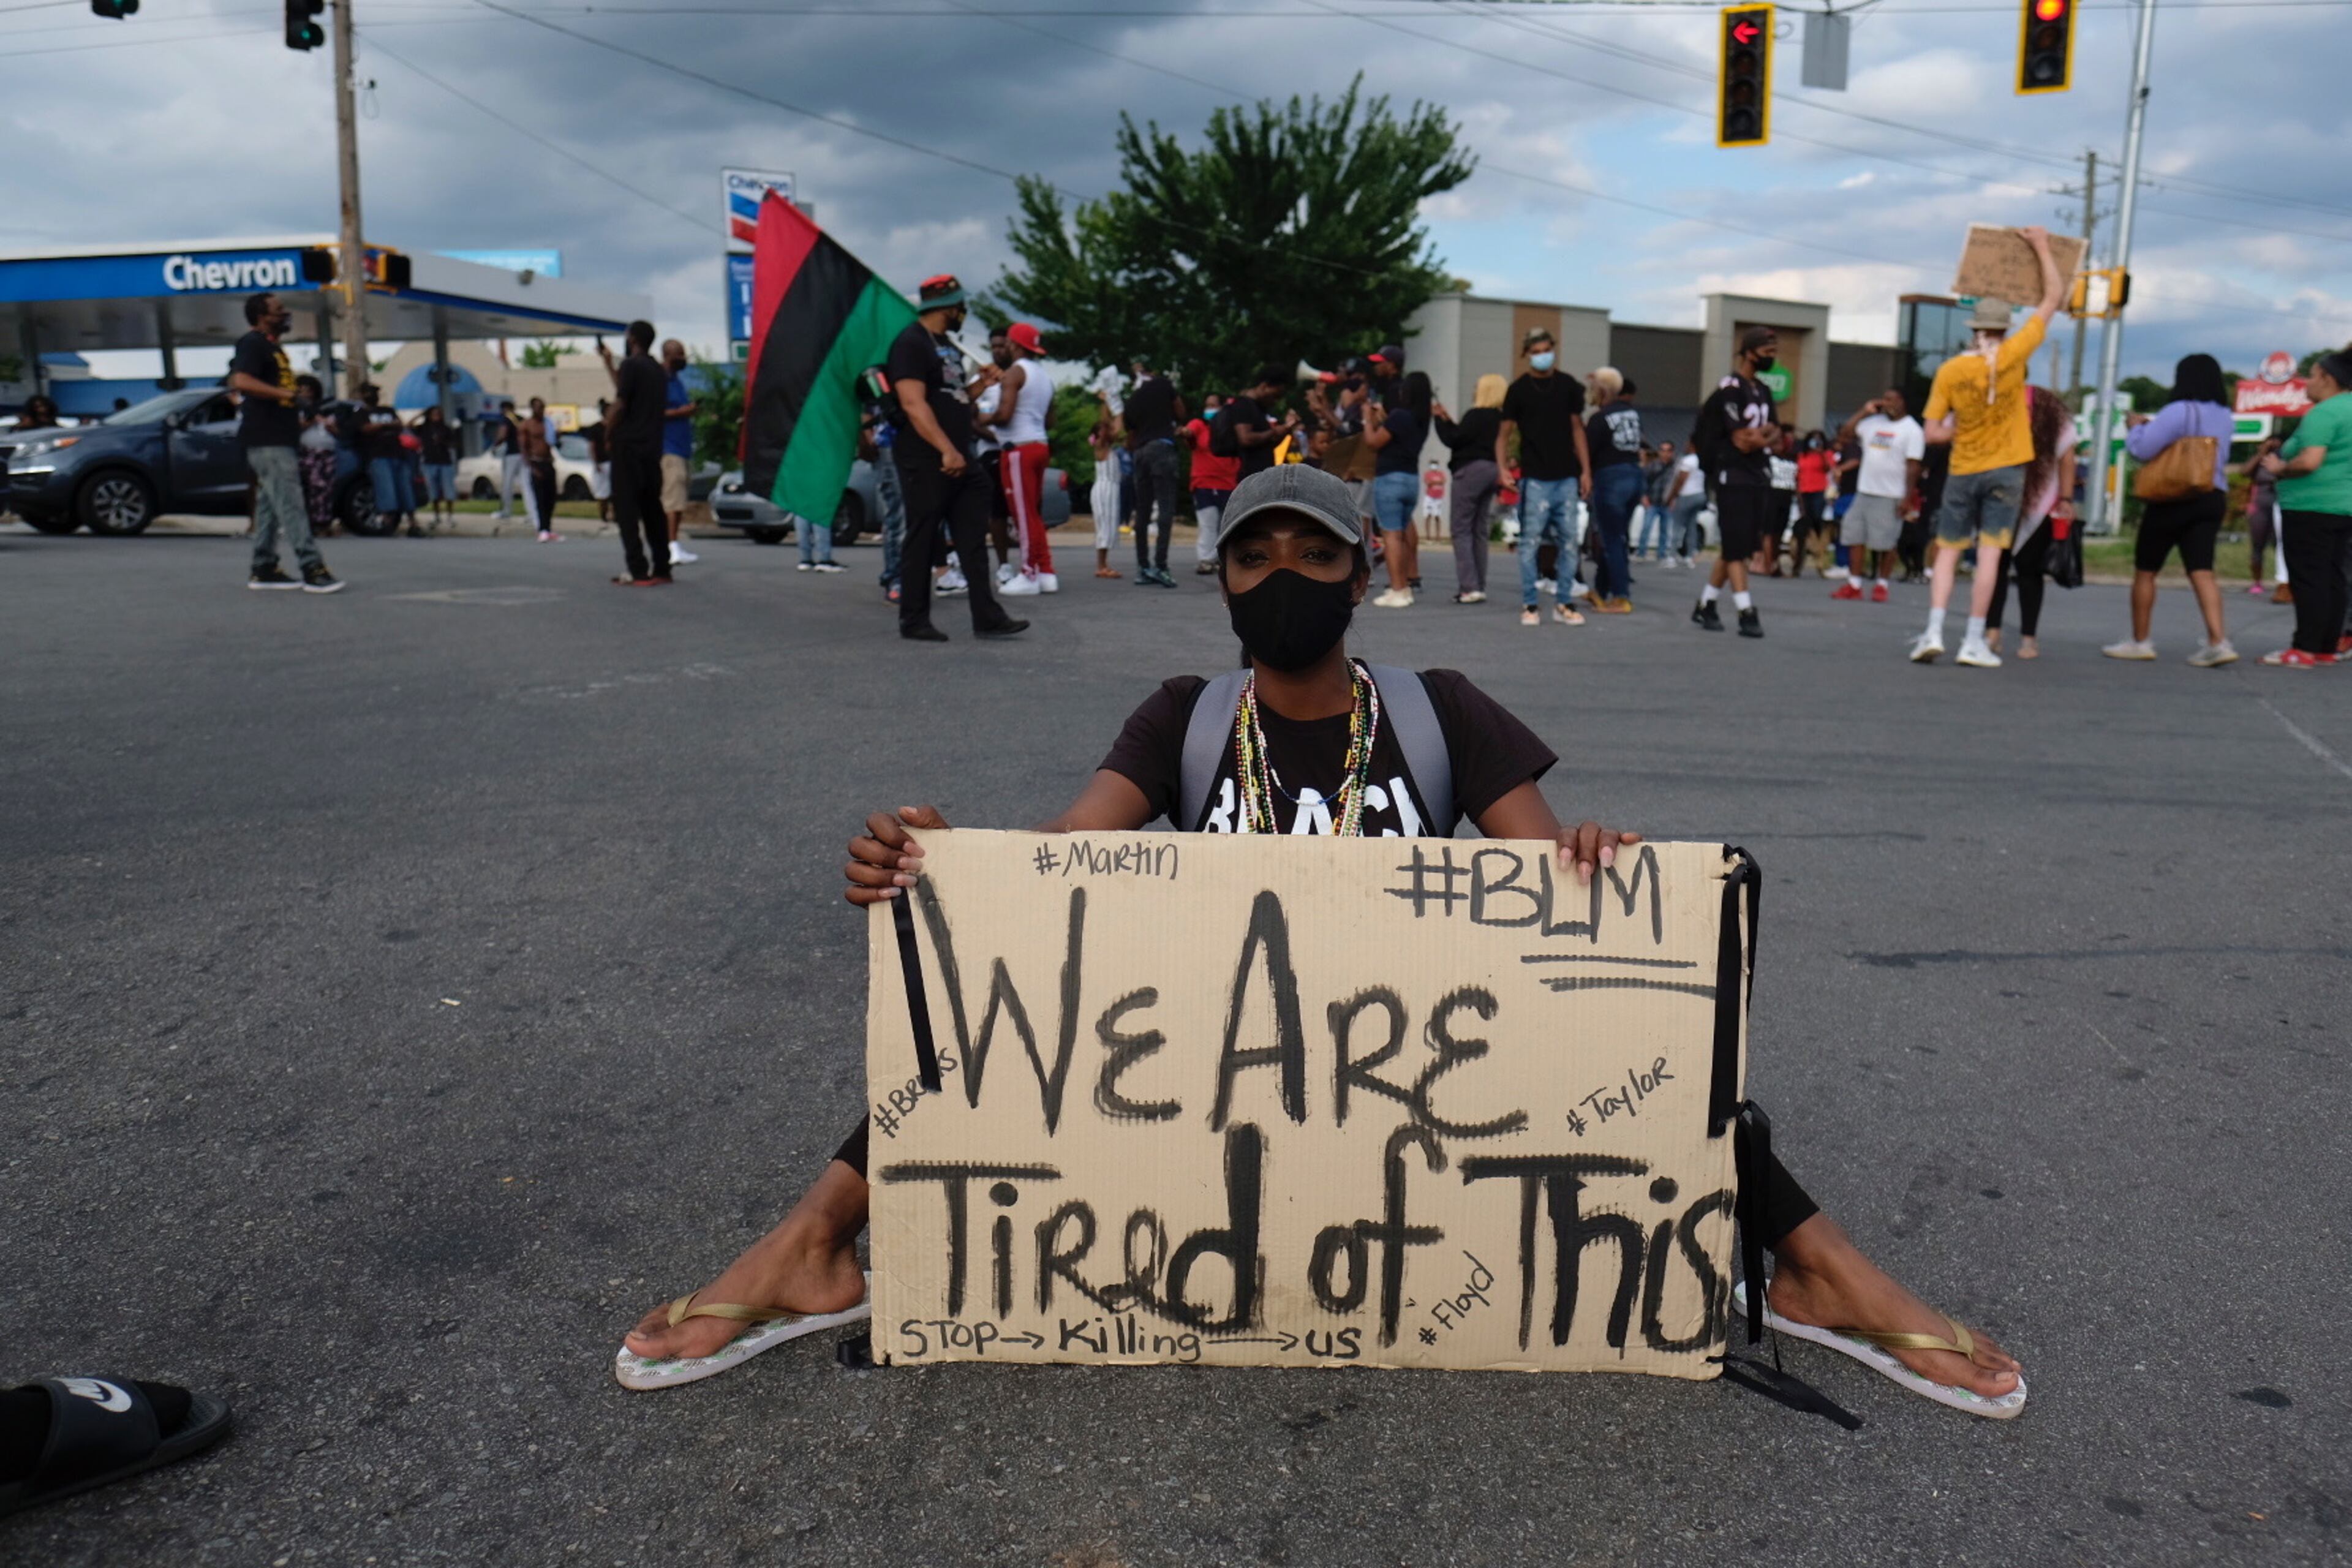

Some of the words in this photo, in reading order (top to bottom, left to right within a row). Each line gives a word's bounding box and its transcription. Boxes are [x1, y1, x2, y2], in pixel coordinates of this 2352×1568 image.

[163, 255, 296, 290] Chevron
[1383, 844, 1662, 944] #BLM
[873, 1047, 958, 1139] #BRS
[1308, 1122, 1447, 1348] of
[1458, 1152, 1735, 1359] This
[900, 1319, 999, 1357] STOP
[1058, 1317, 1202, 1362] Killing
[1419, 1250, 1494, 1346] #Floyd
